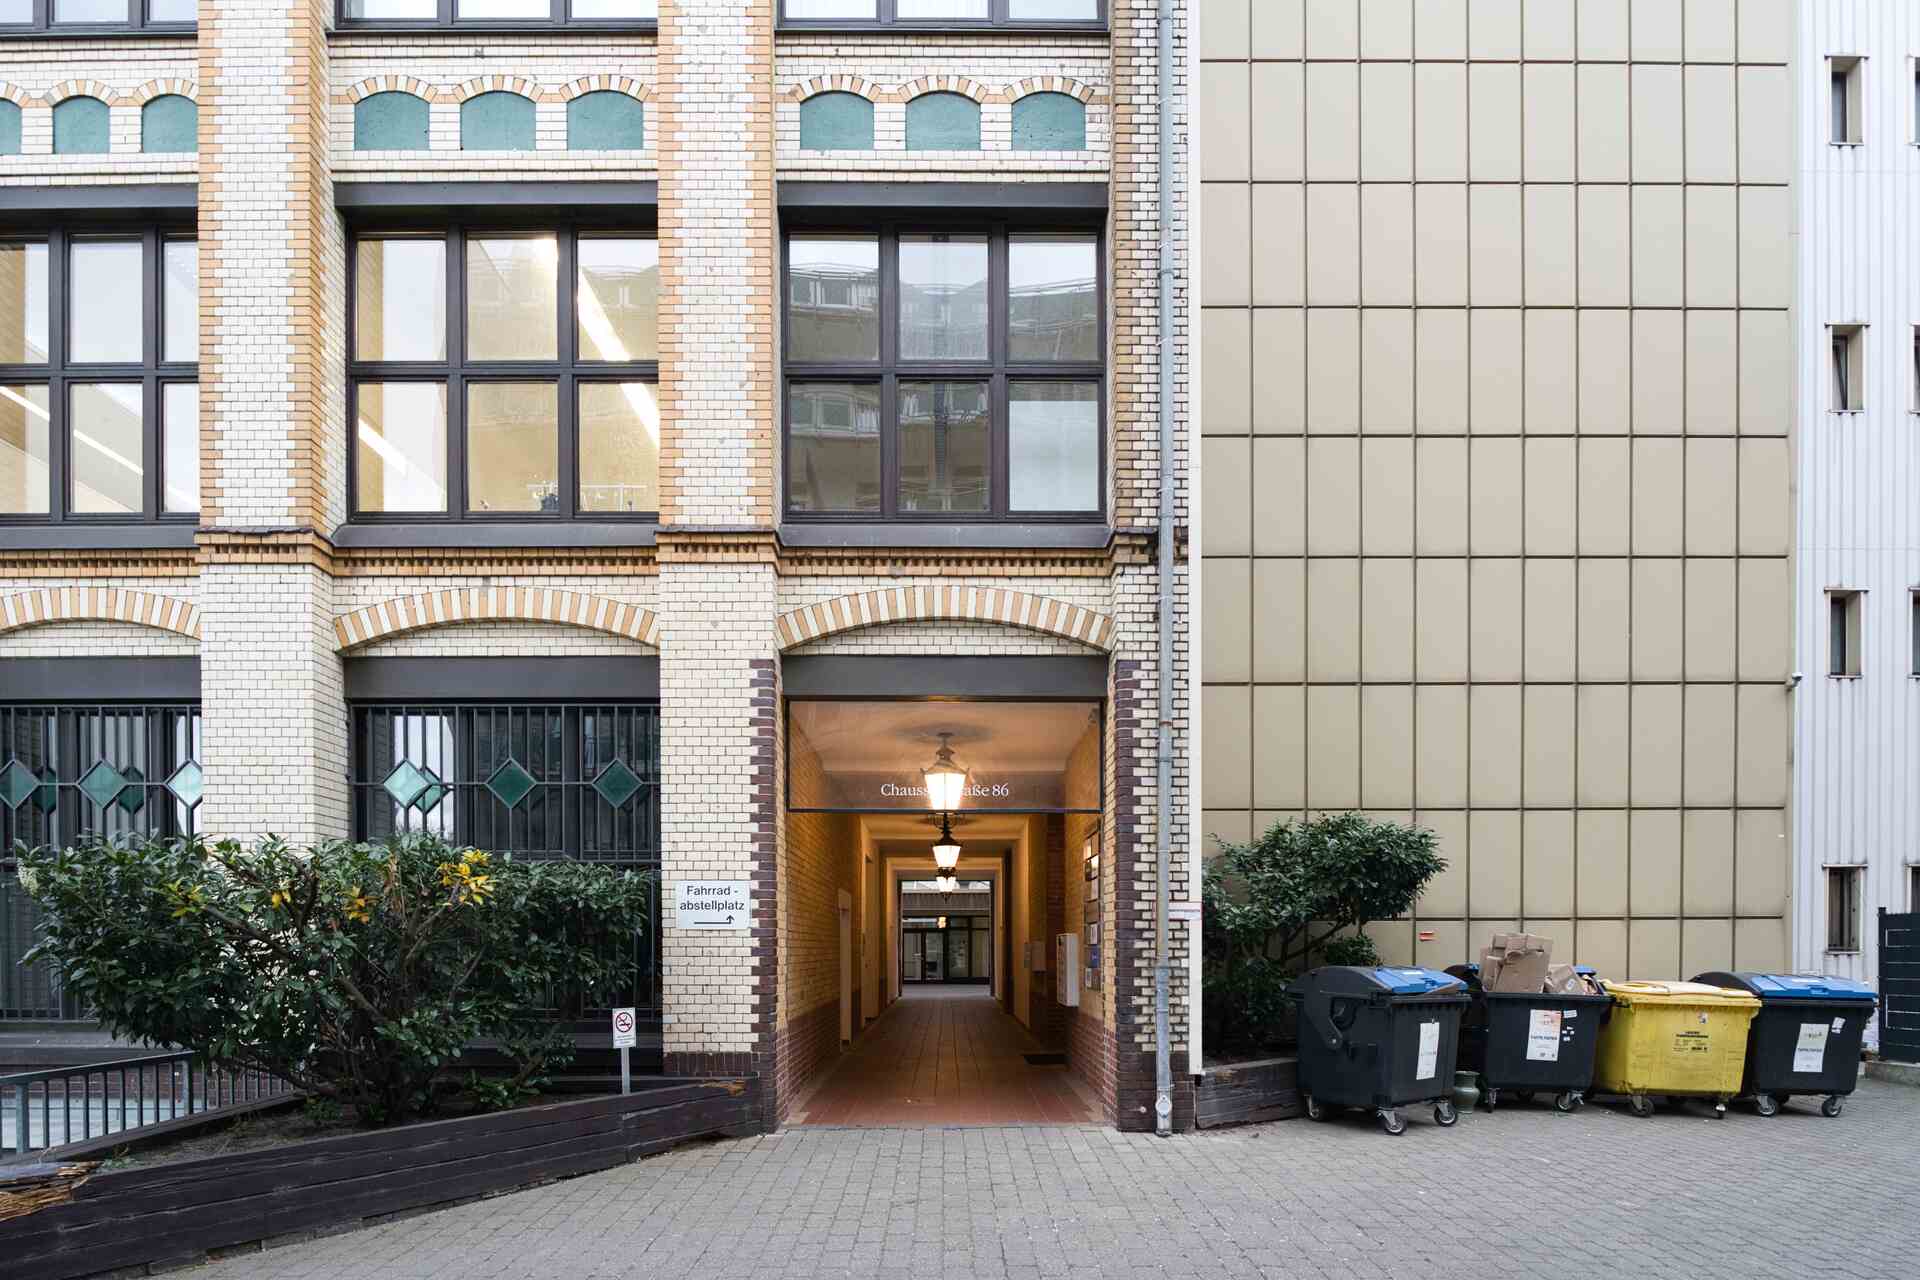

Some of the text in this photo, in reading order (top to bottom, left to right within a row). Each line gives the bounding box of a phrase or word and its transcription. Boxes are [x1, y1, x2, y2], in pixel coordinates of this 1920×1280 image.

[991, 783, 1009, 797] 86
[686, 885, 731, 896] Fahrrad
[679, 900, 745, 912] abstellplatz
